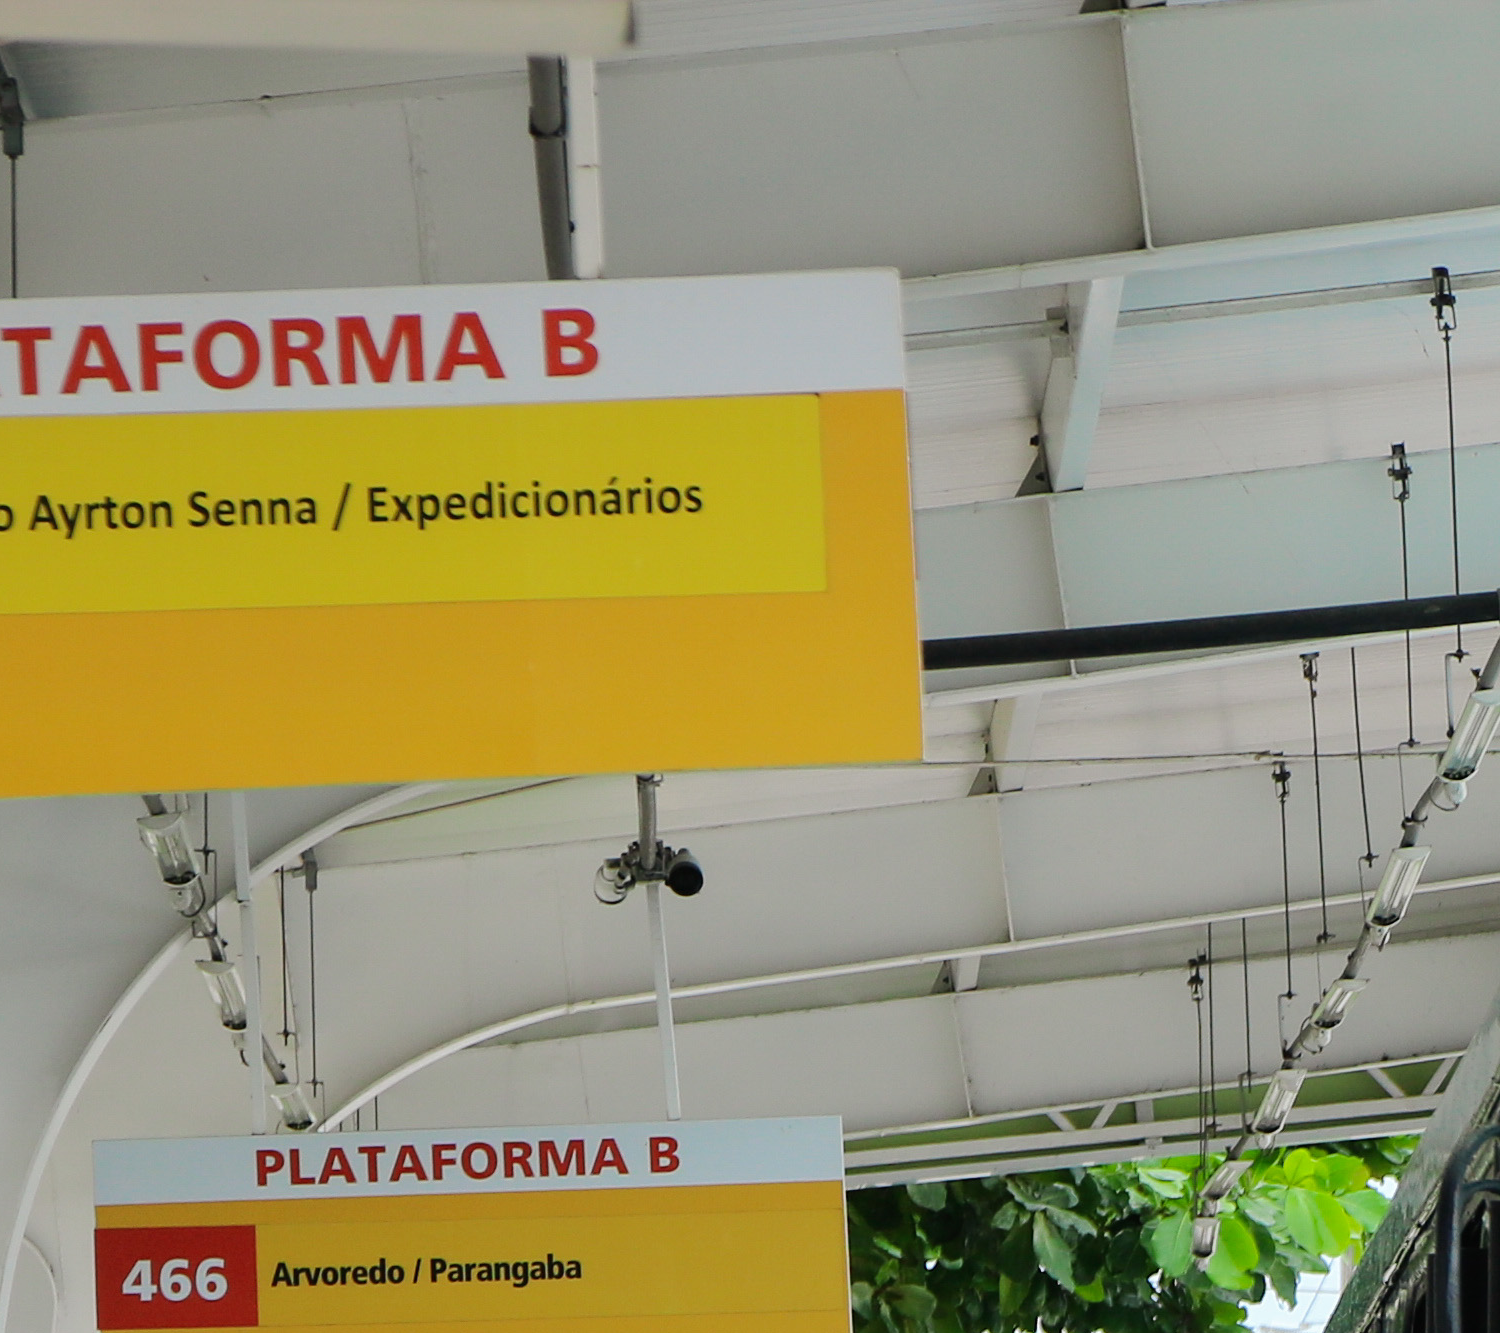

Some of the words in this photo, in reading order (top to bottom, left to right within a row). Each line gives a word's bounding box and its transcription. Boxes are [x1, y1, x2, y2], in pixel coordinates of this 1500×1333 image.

[543, 309, 598, 378] B
[29, 494, 174, 541] Ayrton
[188, 489, 318, 529] Senna
[368, 476, 704, 531] Expedicionários
[256, 1138, 629, 1187] PLATAFORMA
[650, 1136, 681, 1173] B
[121, 1257, 228, 1302] 466
[270, 1256, 406, 1288] Arvoredo
[430, 1253, 583, 1289] Parangaba
